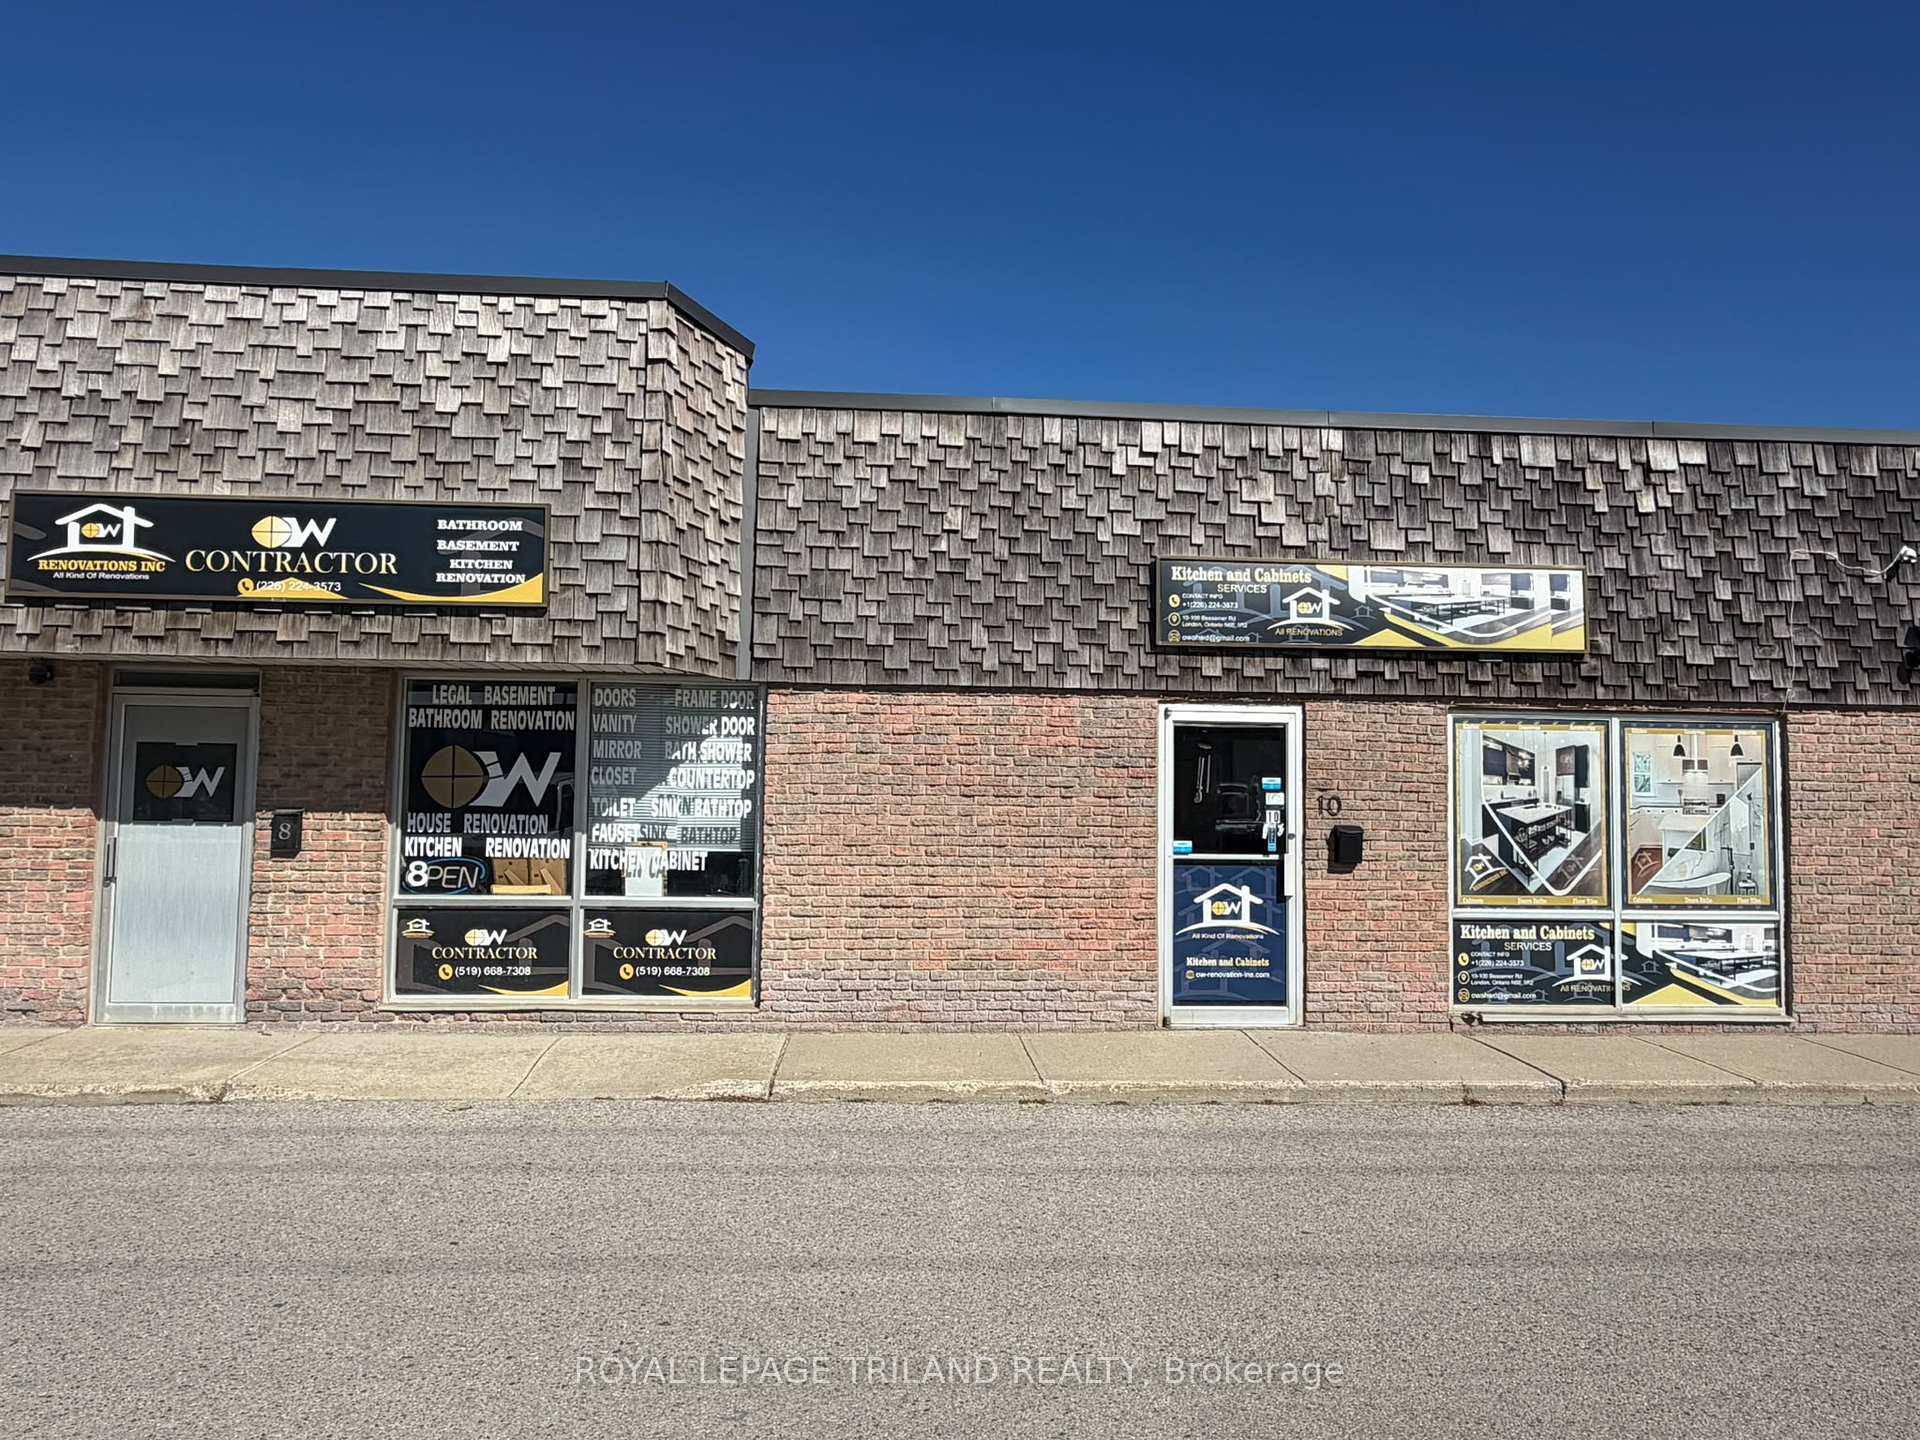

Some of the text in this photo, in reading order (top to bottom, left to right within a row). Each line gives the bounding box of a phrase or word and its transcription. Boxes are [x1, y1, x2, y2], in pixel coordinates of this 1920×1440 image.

[437, 519, 523, 531] BATHROOM
[436, 540, 520, 552] BASEMENT
[38, 559, 166, 572] RENOVATIONS INC
[185, 550, 398, 575] CONTRACTOR
[449, 559, 513, 570] KITCHEN
[53, 571, 150, 581] All Kind Of Renovations
[436, 573, 526, 584] RENOVATION
[1171, 566, 1312, 584] Kitchen and Cabinets
[256, 580, 342, 592] (226) 224-3573
[1217, 584, 1267, 594] SERVICES
[1286, 628, 1343, 637] RENOVATIONS
[432, 684, 556, 706] LEGAL BASEMENT
[595, 688, 637, 707] DOORS
[675, 689, 755, 710] FRAME DOOR
[408, 708, 575, 731] BATHROOM RENOVATION
[592, 714, 637, 733] VANITY
[665, 716, 755, 736] SHOWER DOOR
[593, 740, 642, 759] MIRROR
[665, 741, 752, 762] BATH SHOWER
[591, 766, 637, 785] CLOSET
[668, 767, 755, 789] COUNTERTOP
[592, 797, 752, 818] TOILET SINK BATHTOP
[1317, 795, 1342, 816] 10
[278, 823, 292, 840] 8
[407, 812, 548, 834] HOUSE RENOVATION
[405, 836, 571, 859] KITCHEN RENOVATION
[588, 849, 708, 871] KITCHEN CABINET
[1460, 924, 1595, 940] Kitchen and Cabinets
[432, 947, 538, 960] CONTRACTOR
[613, 947, 717, 960] CONTRACTOR
[1504, 941, 1553, 951] SERVICES
[1186, 957, 1269, 967] Kitchen and Cabinets
[455, 966, 531, 978] (519) 668-7308
[635, 966, 710, 978] (519) 668-7308
